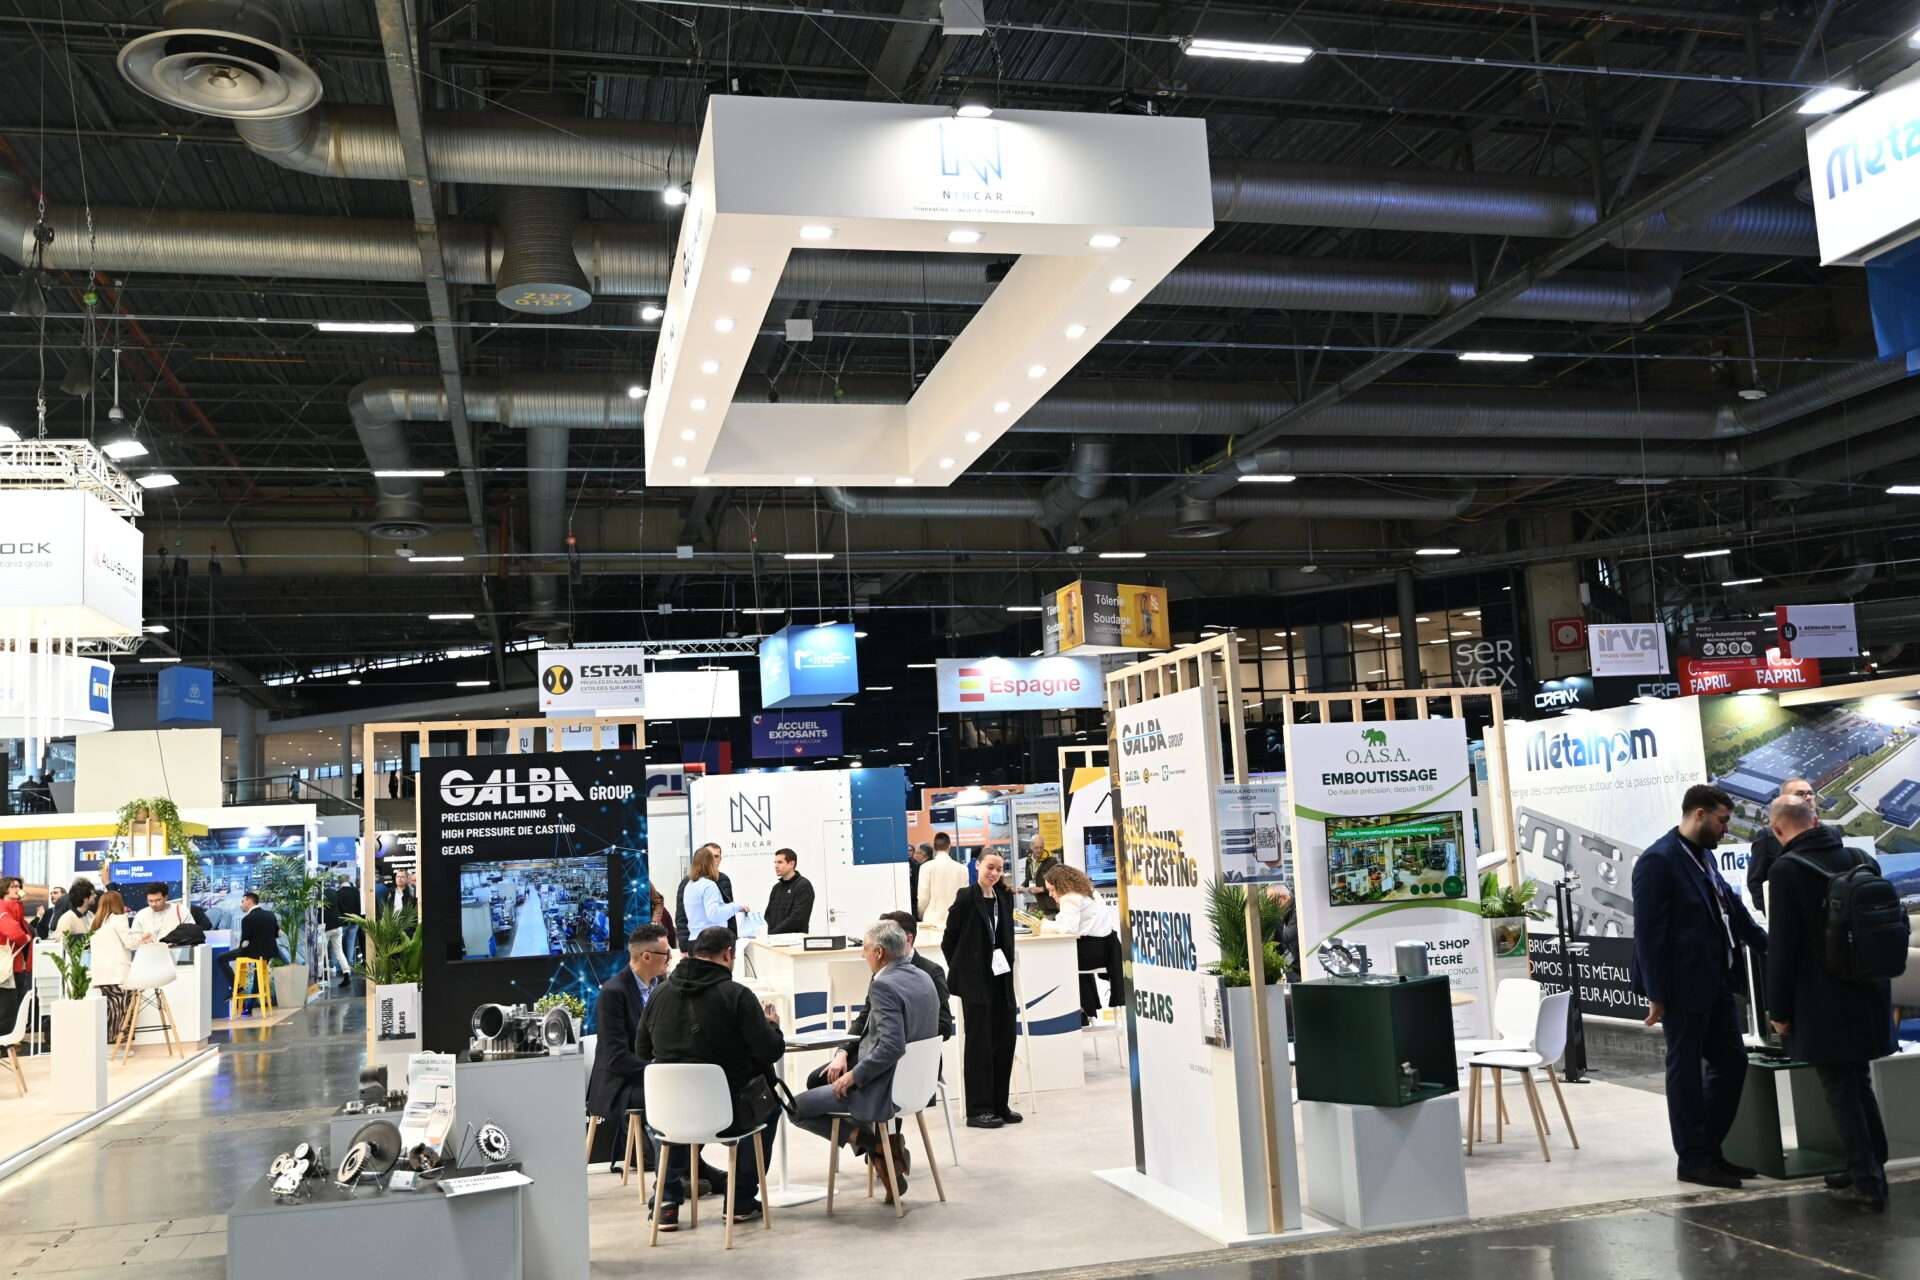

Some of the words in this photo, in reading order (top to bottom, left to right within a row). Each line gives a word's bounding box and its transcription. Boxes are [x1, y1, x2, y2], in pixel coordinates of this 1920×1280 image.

[1598, 628, 1657, 651] irva
[580, 664, 642, 677] ESTRAL
[1755, 669, 1807, 684] FAPRIL
[989, 677, 1081, 697] Espagne
[1637, 682, 1680, 697] CRA
[1690, 674, 1731, 692] FAPRIL
[777, 721, 819, 730] ACCUEIL
[768, 729, 828, 739] EXPOSANTS
[1122, 719, 1167, 756] GALBA
[1322, 768, 1437, 785] EMBOUTISSAGE
[440, 767, 585, 806] GALBA
[589, 785, 633, 800] GROUP
[1328, 788, 1338, 796] De
[441, 811, 491, 823] PRECISION
[493, 809, 546, 820] MACHINING
[441, 828, 464, 839] HIGH
[466, 826, 516, 838] PRESSURE
[518, 825, 534, 836] DIE
[535, 823, 576, 835] CASTING
[441, 845, 474, 855] GEARS
[732, 840, 772, 849] NINCAR
[1720, 851, 1752, 871] Mét
[1145, 857, 1198, 887] CASTING
[1129, 910, 1192, 944] PRECISION
[1424, 941, 1436, 951] OL
[1439, 939, 1470, 950] SHOP
[1132, 936, 1197, 971] MACHINING
[1428, 952, 1463, 966] TÉGRÉ
[1529, 960, 1590, 979] OMPOSTS
[1592, 962, 1631, 983] MÉTALL
[1134, 989, 1174, 1024] GEARS
